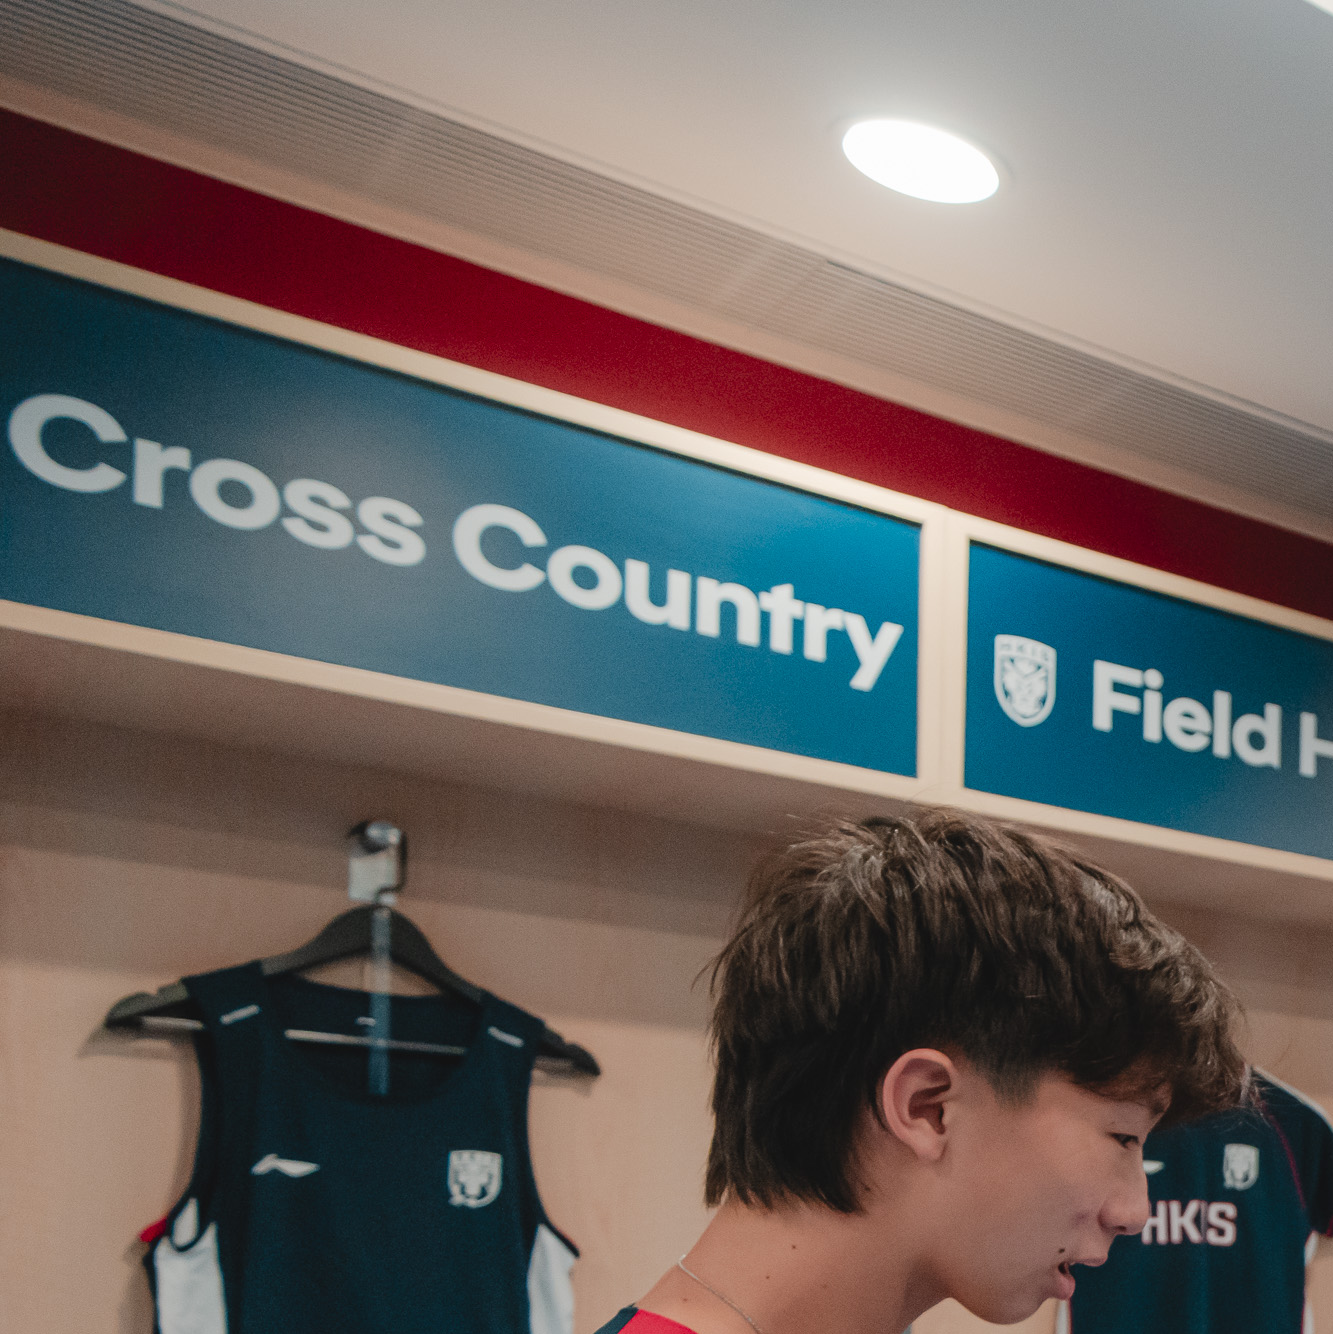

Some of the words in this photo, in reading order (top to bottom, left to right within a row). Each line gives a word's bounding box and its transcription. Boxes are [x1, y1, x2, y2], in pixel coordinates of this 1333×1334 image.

[9, 394, 428, 568] Cross
[452, 502, 904, 692] Country
[1092, 658, 1281, 768] Field
